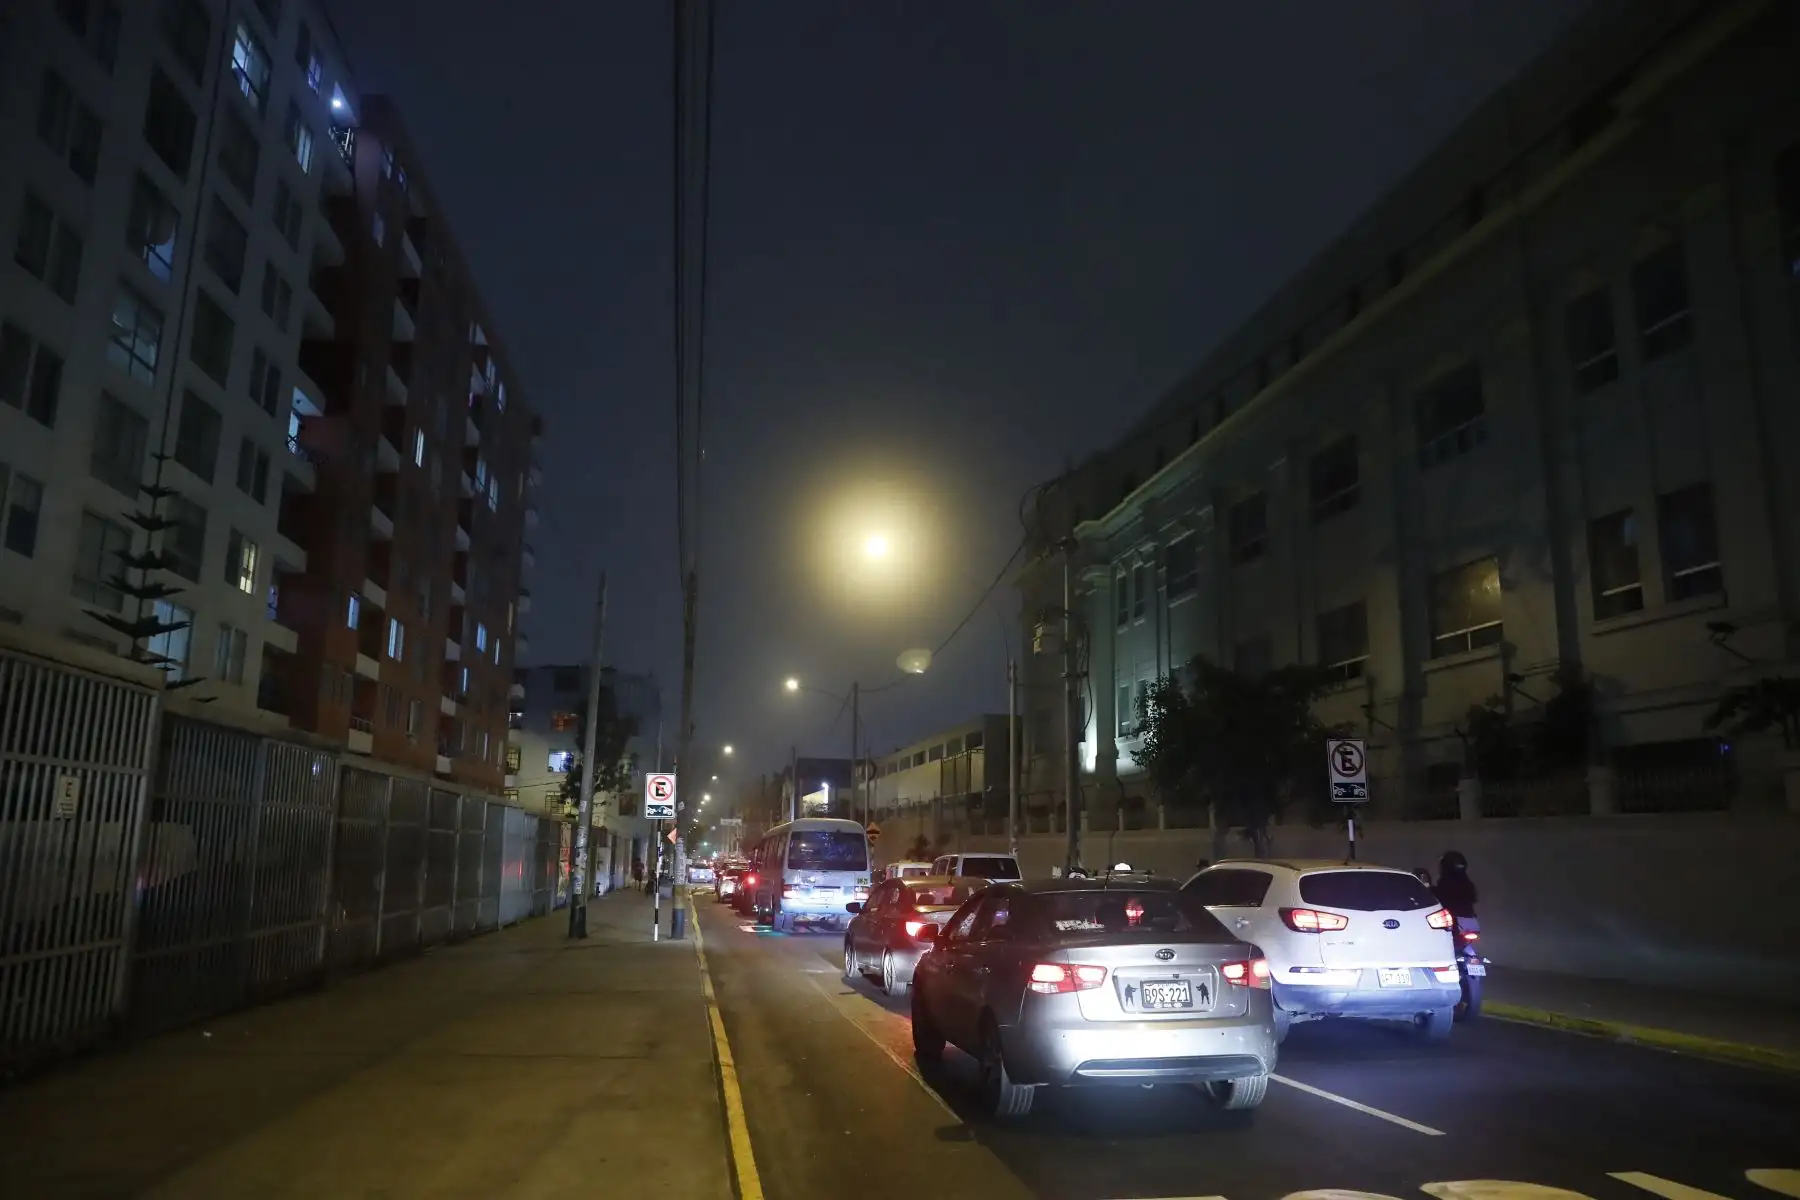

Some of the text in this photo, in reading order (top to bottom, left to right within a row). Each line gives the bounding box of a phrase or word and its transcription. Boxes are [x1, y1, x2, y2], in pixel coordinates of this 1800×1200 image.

[1341, 751, 1354, 771] E
[656, 782, 666, 796] E
[1145, 988, 1189, 1004] B9S-221
